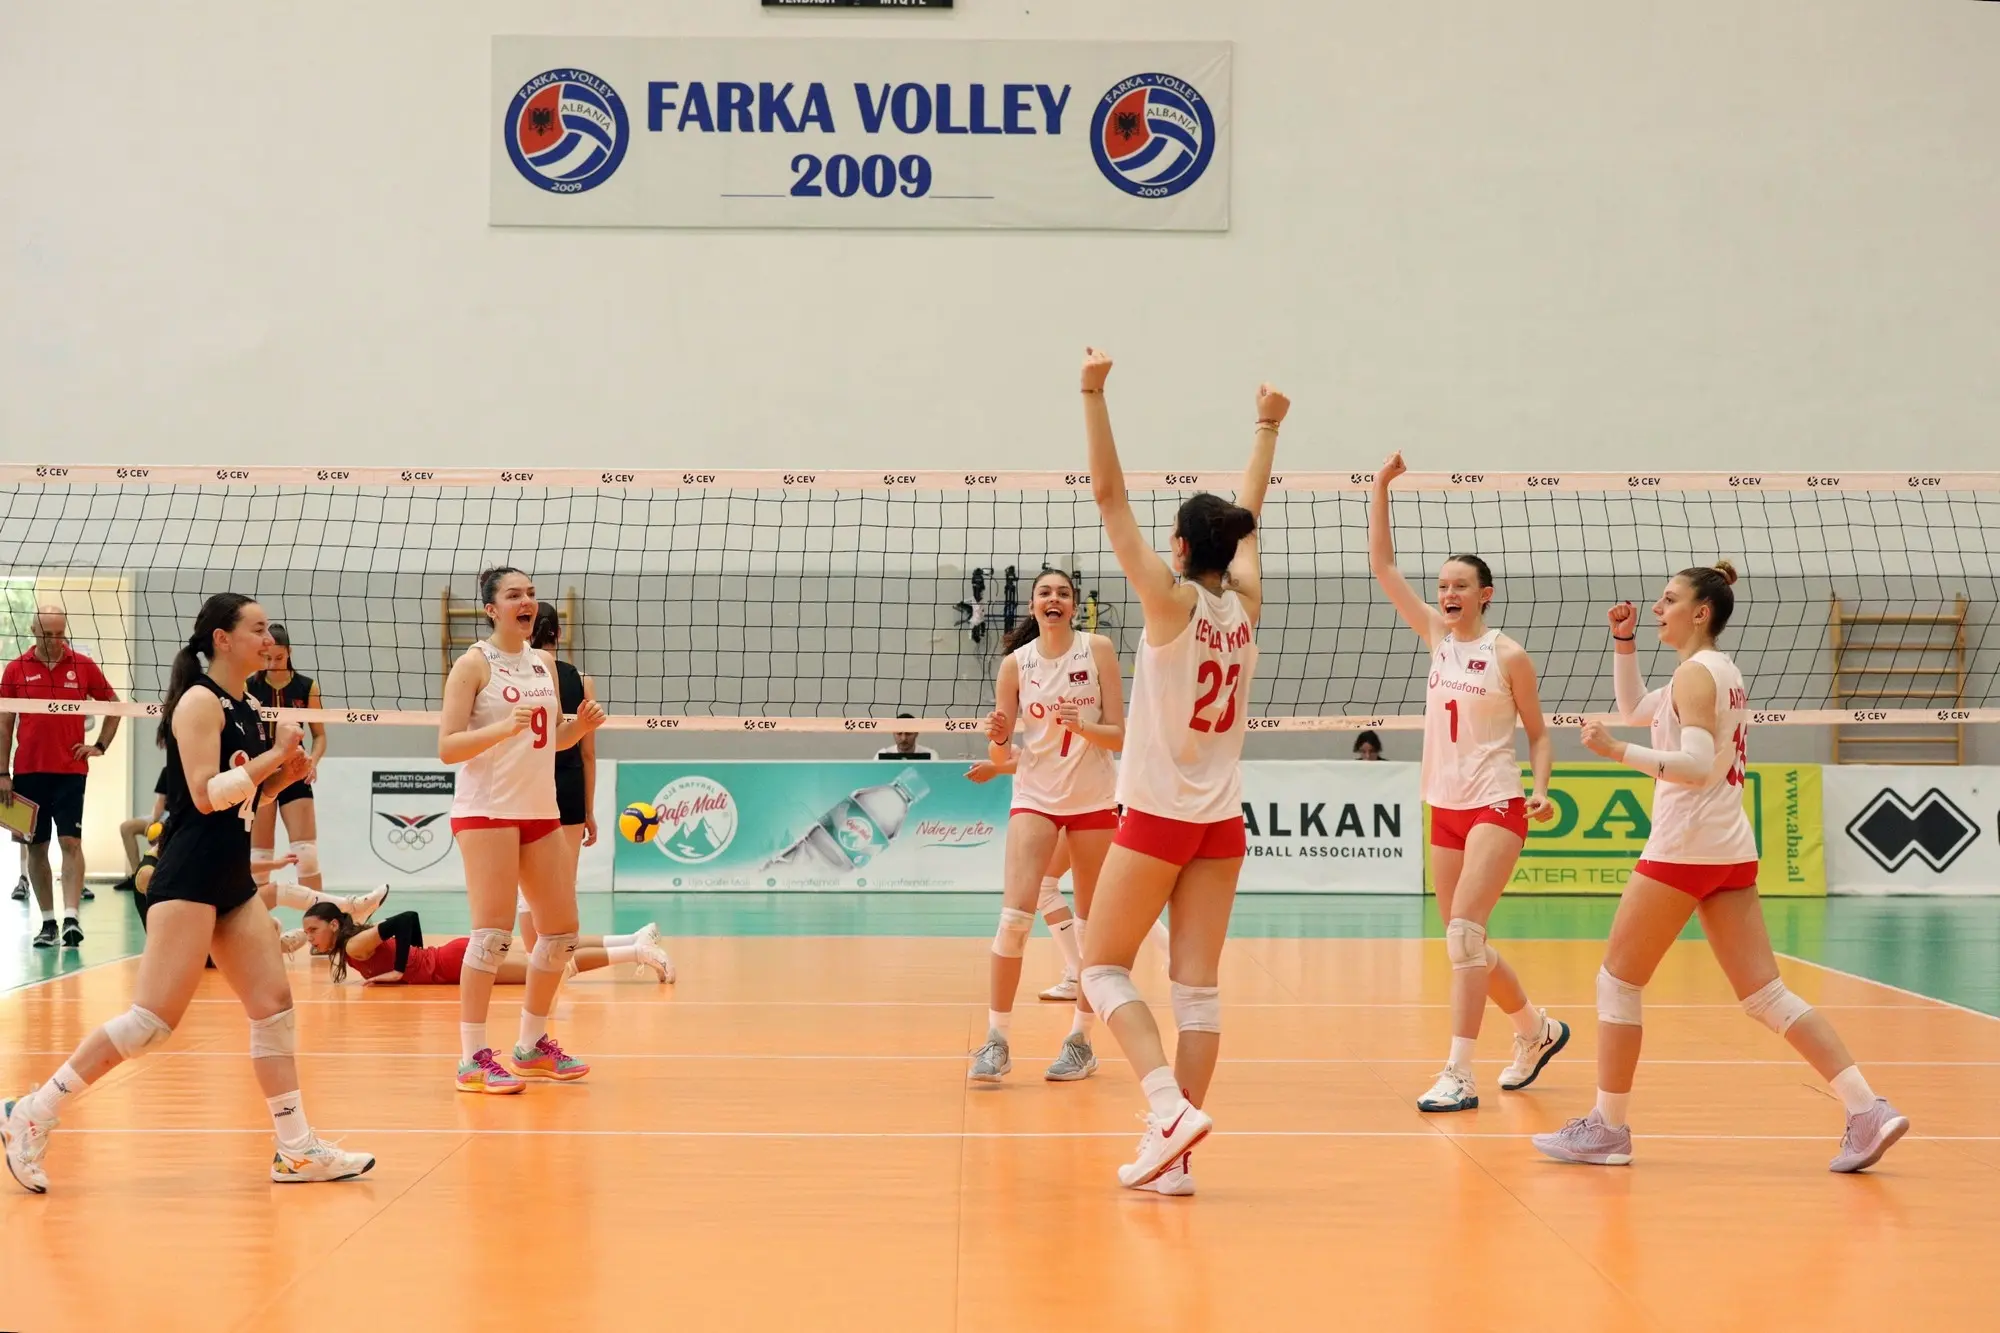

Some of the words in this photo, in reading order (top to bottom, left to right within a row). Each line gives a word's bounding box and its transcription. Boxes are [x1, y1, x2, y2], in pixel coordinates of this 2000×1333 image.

[519, 72, 559, 100] FARKA
[569, 70, 615, 99] VOLLEY
[1104, 76, 1145, 104] FARKA
[1155, 75, 1200, 103] VOLLEY
[647, 81, 836, 133] FARKA
[854, 82, 1072, 135] VOLLEY
[560, 103, 611, 130] ALBANIA
[1146, 107, 1197, 135] ALBANIA
[790, 153, 932, 198] 2009
[551, 182, 583, 193] 2009
[1137, 187, 1168, 197] 2009
[49, 467, 69, 477] CEV
[129, 469, 150, 478] CEV
[229, 470, 250, 480] CEV
[330, 471, 350, 480] CEV
[414, 471, 434, 481] CEV
[514, 472, 534, 482] CEV
[614, 474, 635, 483] CEV
[695, 474, 716, 484] CEV
[796, 475, 816, 484] CEV
[896, 475, 917, 484] CEV
[977, 475, 998, 484] CEV
[1078, 475, 1091, 484] CE
[1178, 475, 1199, 484] CEV
[1464, 474, 1485, 483] CEV
[1540, 477, 1560, 486] CEV
[1641, 477, 1661, 486] CEV
[1741, 477, 1762, 486] CEV
[1820, 477, 1840, 486] CEV
[1921, 477, 1942, 486] CEV
[521, 685, 554, 698] vodafo
[1440, 678, 1487, 696] vodafone
[60, 703, 82, 713] CEV
[1046, 696, 1096, 713] vofone
[259, 710, 280, 720] CEV
[359, 713, 380, 722] CEV
[1766, 713, 1787, 722] CEV
[1867, 711, 1887, 721] CEV
[1950, 711, 1971, 720] CEV
[659, 719, 680, 728] CEV
[757, 720, 777, 729] CEV
[857, 720, 878, 729] CEV
[958, 721, 978, 730] CEV
[1260, 719, 1281, 728] CEV
[1444, 699, 1459, 744] 1
[530, 705, 549, 750] 9
[690, 792, 728, 816] Mali
[1241, 801, 1401, 838] ALKAN
[1785, 769, 1805, 882] www.aba.al
[1245, 846, 1293, 857] YBALL
[1299, 846, 1403, 858] ASSOCIATION
[1513, 867, 1578, 883] ATER
[1585, 867, 1633, 884] TEC
